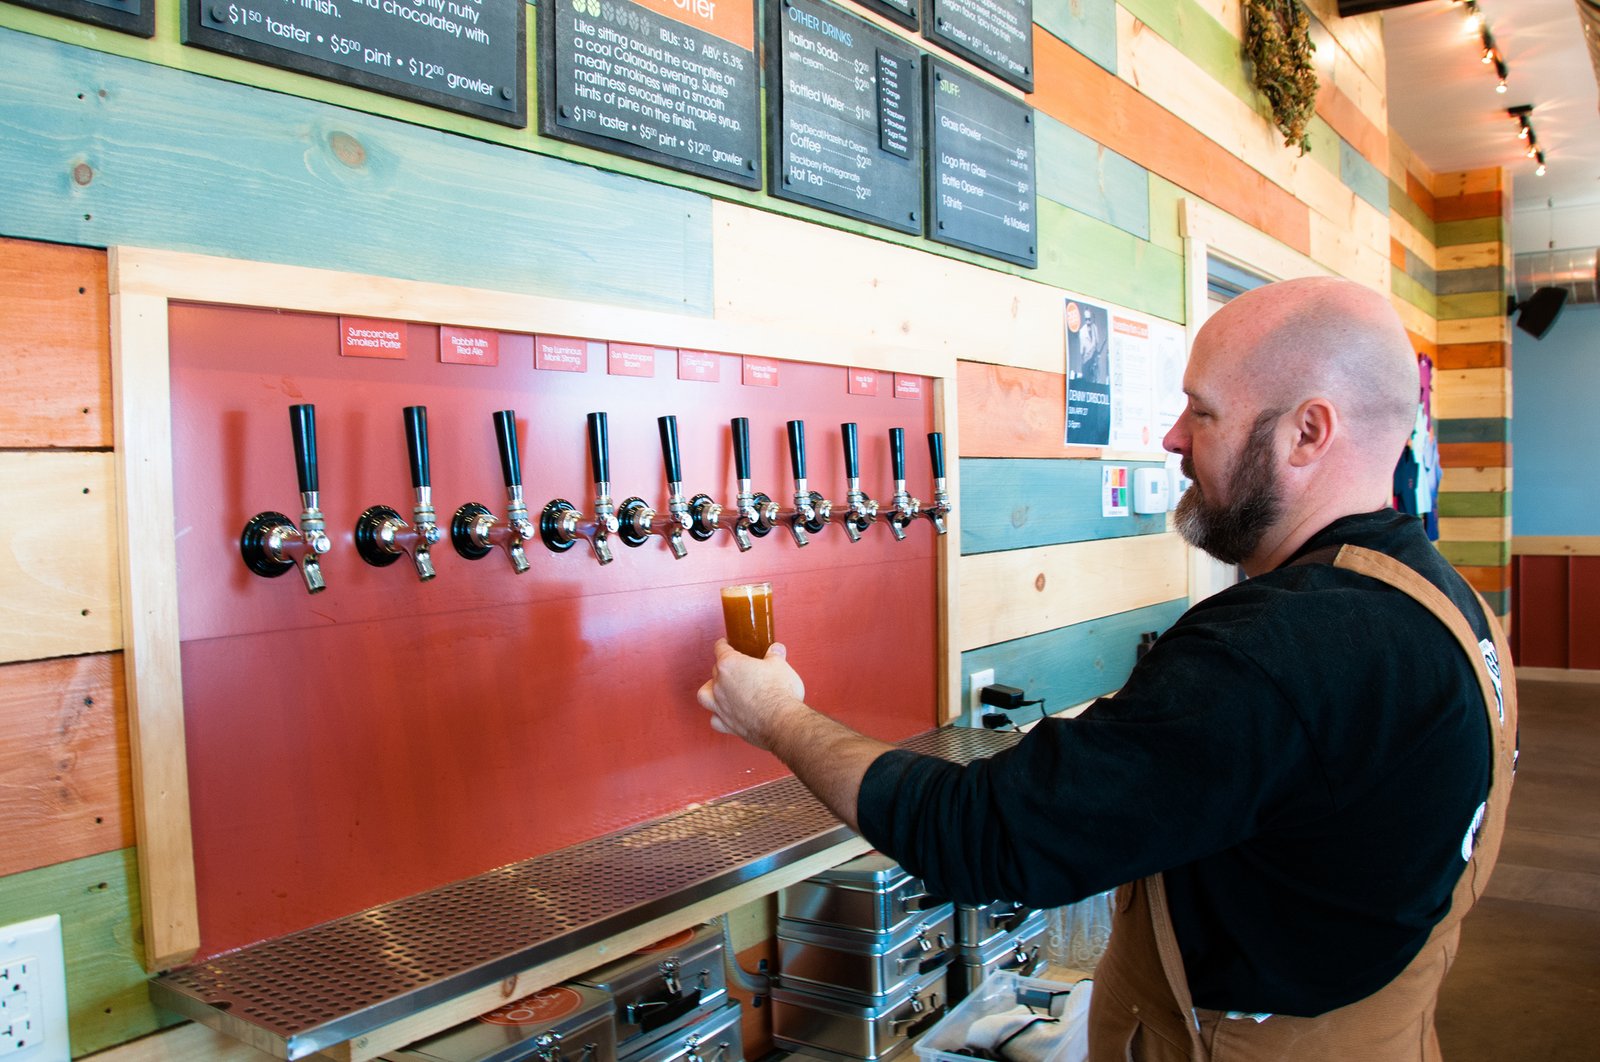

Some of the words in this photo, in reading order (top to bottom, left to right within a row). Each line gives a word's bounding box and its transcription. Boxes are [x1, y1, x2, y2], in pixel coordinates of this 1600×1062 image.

[383, 1, 462, 38] chocolatey
[464, 26, 490, 46] with
[448, 2, 480, 25] nutty
[788, 7, 820, 32] OTHER
[821, 21, 854, 48] DRINKS:
[265, 16, 311, 44] taster
[364, 47, 392, 67] pint
[447, 72, 494, 96] growler
[574, 18, 596, 36] Like
[597, 26, 628, 50] sitting
[630, 39, 663, 61] around
[663, 50, 681, 67] the
[681, 58, 723, 82] campfire
[724, 74, 736, 87] on
[683, 36, 695, 52] 33
[702, 44, 721, 62] ABV:
[722, 52, 744, 71] 5.3%
[788, 29, 816, 53] Italian
[816, 41, 839, 63] Soda
[573, 37, 583, 49] a
[585, 40, 612, 57] cool
[613, 46, 659, 74] Colorado
[660, 66, 700, 91] evening.
[702, 78, 729, 99] Subtle
[788, 50, 802, 62] with
[802, 56, 825, 71] cream
[574, 52, 612, 75] meaty
[613, 63, 661, 91] smokiness
[661, 81, 682, 97] with
[682, 88, 691, 100] a
[691, 91, 725, 111] smooth
[940, 79, 961, 98] STUFF:
[574, 68, 628, 93] maltiness
[628, 84, 674, 109] evocative
[675, 100, 686, 113] of
[687, 104, 718, 123] maple
[718, 114, 742, 132] syrup.
[574, 82, 602, 102] Hints
[603, 92, 616, 105] of
[617, 96, 640, 113] pine
[641, 105, 654, 118] on
[655, 107, 671, 124] the
[672, 112, 698, 132] finish.
[789, 79, 821, 103] Bottled
[821, 91, 845, 112] Water
[599, 112, 630, 133] taster
[658, 133, 678, 148] pint
[712, 148, 744, 167] growler
[941, 115, 959, 132] Glass
[959, 123, 982, 141] Growler
[790, 132, 822, 154] Coffee
[848, 139, 869, 155] Cream
[789, 152, 823, 172] Blackberry
[941, 152, 959, 169] Logo
[970, 162, 987, 179] Glass
[790, 165, 806, 181] Hot
[806, 169, 823, 186] Tea
[942, 173, 961, 190] Bottle
[961, 180, 984, 197] Opener
[942, 194, 963, 211] T-Shirts
[346, 336, 379, 347] Smoked
[379, 339, 402, 349] Porter
[348, 326, 400, 340] Sunscorched
[451, 336, 474, 346] Rabbit
[456, 345, 471, 355] Red
[471, 347, 484, 356] Ale
